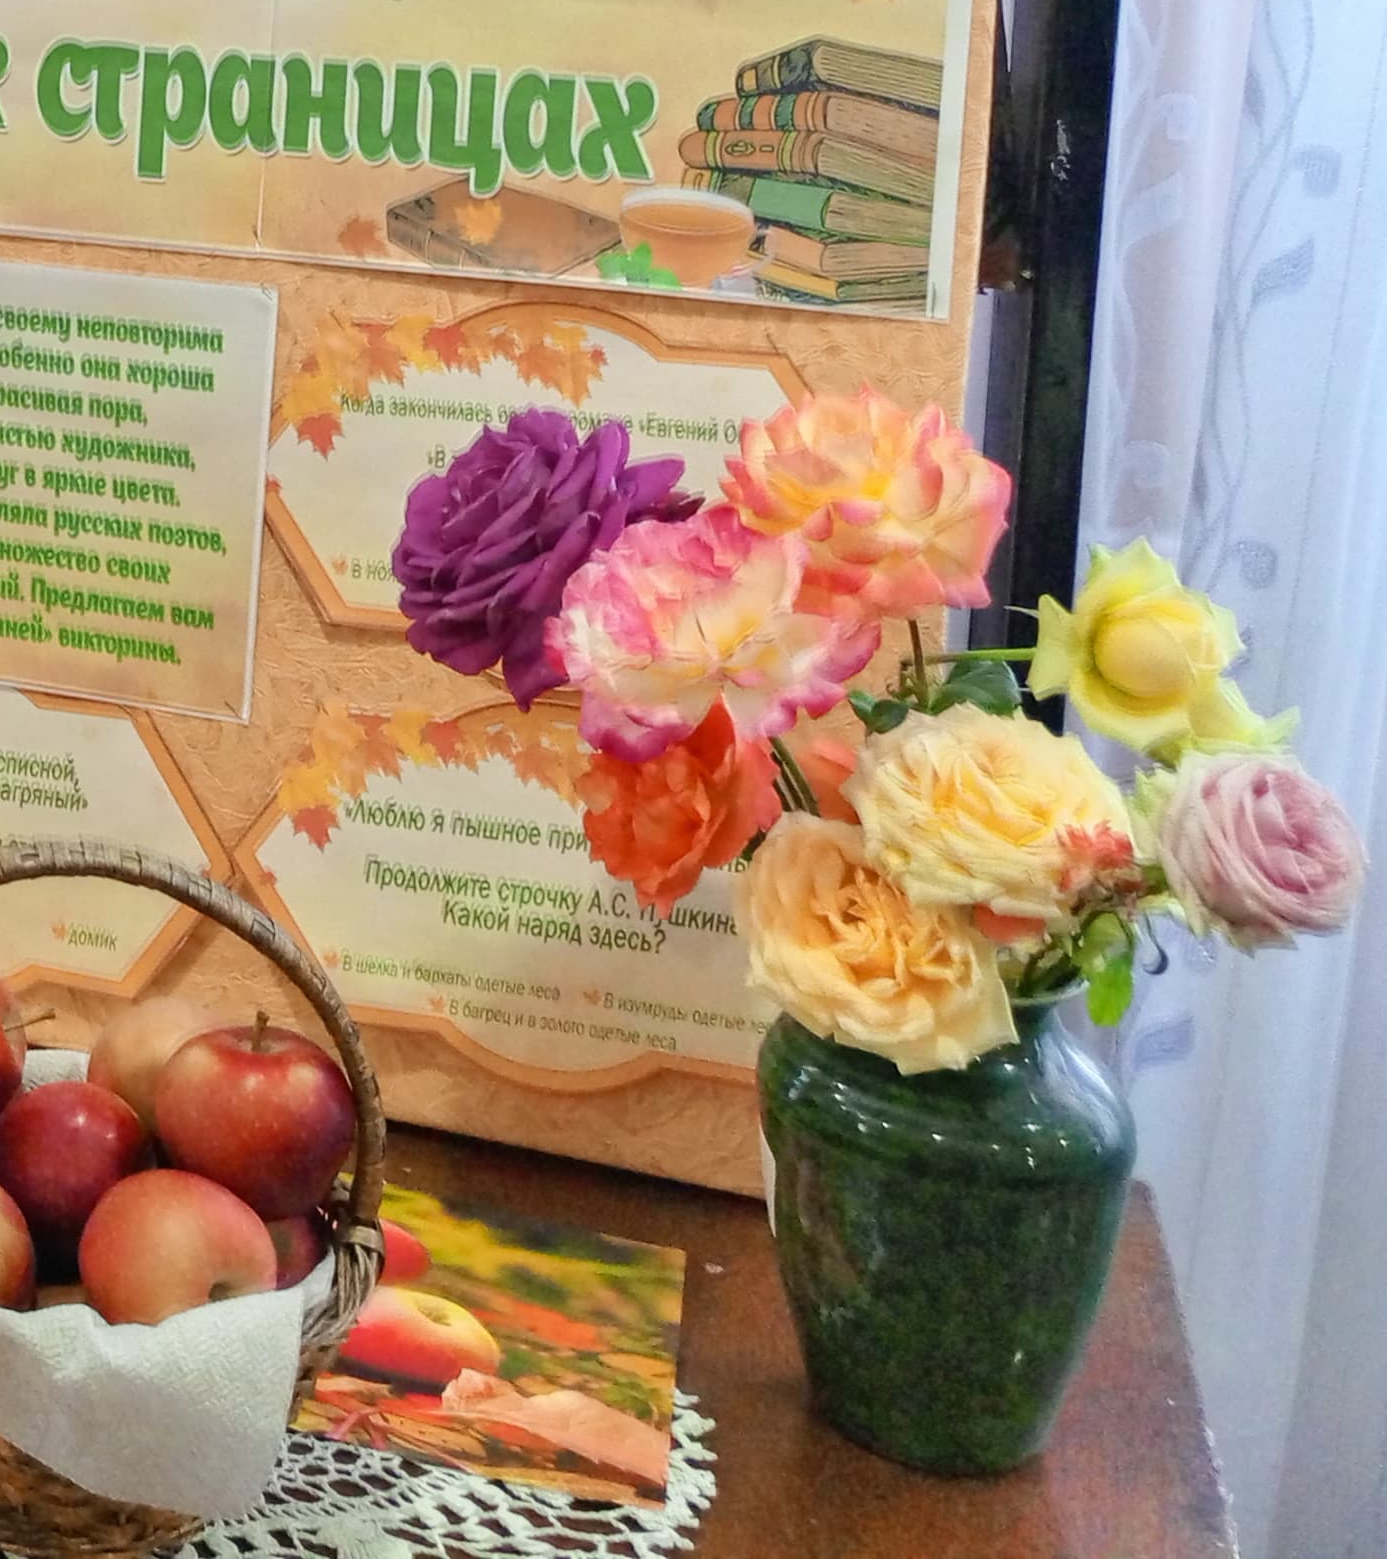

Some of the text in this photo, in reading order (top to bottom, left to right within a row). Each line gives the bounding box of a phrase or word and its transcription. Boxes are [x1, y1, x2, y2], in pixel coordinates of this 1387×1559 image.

[37, 38, 656, 194] страницах
[75, 316, 224, 360] неповторима
[80, 355, 122, 381] она
[126, 360, 215, 398] хороша
[87, 396, 148, 430] пора,
[389, 399, 492, 424] закончилась
[60, 431, 196, 475] художника,
[24, 465, 37, 486] в
[41, 467, 107, 502] яркие
[111, 477, 181, 511] цвета.
[53, 508, 142, 547] русских
[147, 521, 228, 557] поэтов,
[105, 555, 171, 585] своих
[30, 576, 166, 628] Предлагаем
[170, 605, 215, 632] вам
[57, 627, 182, 673] викторины.
[346, 799, 541, 846] «Люблю я пышное
[365, 860, 630, 918] Продолжите строчку А.С.
[68, 927, 118, 951] домик
[443, 900, 667, 954] Какой наряд здесь?
